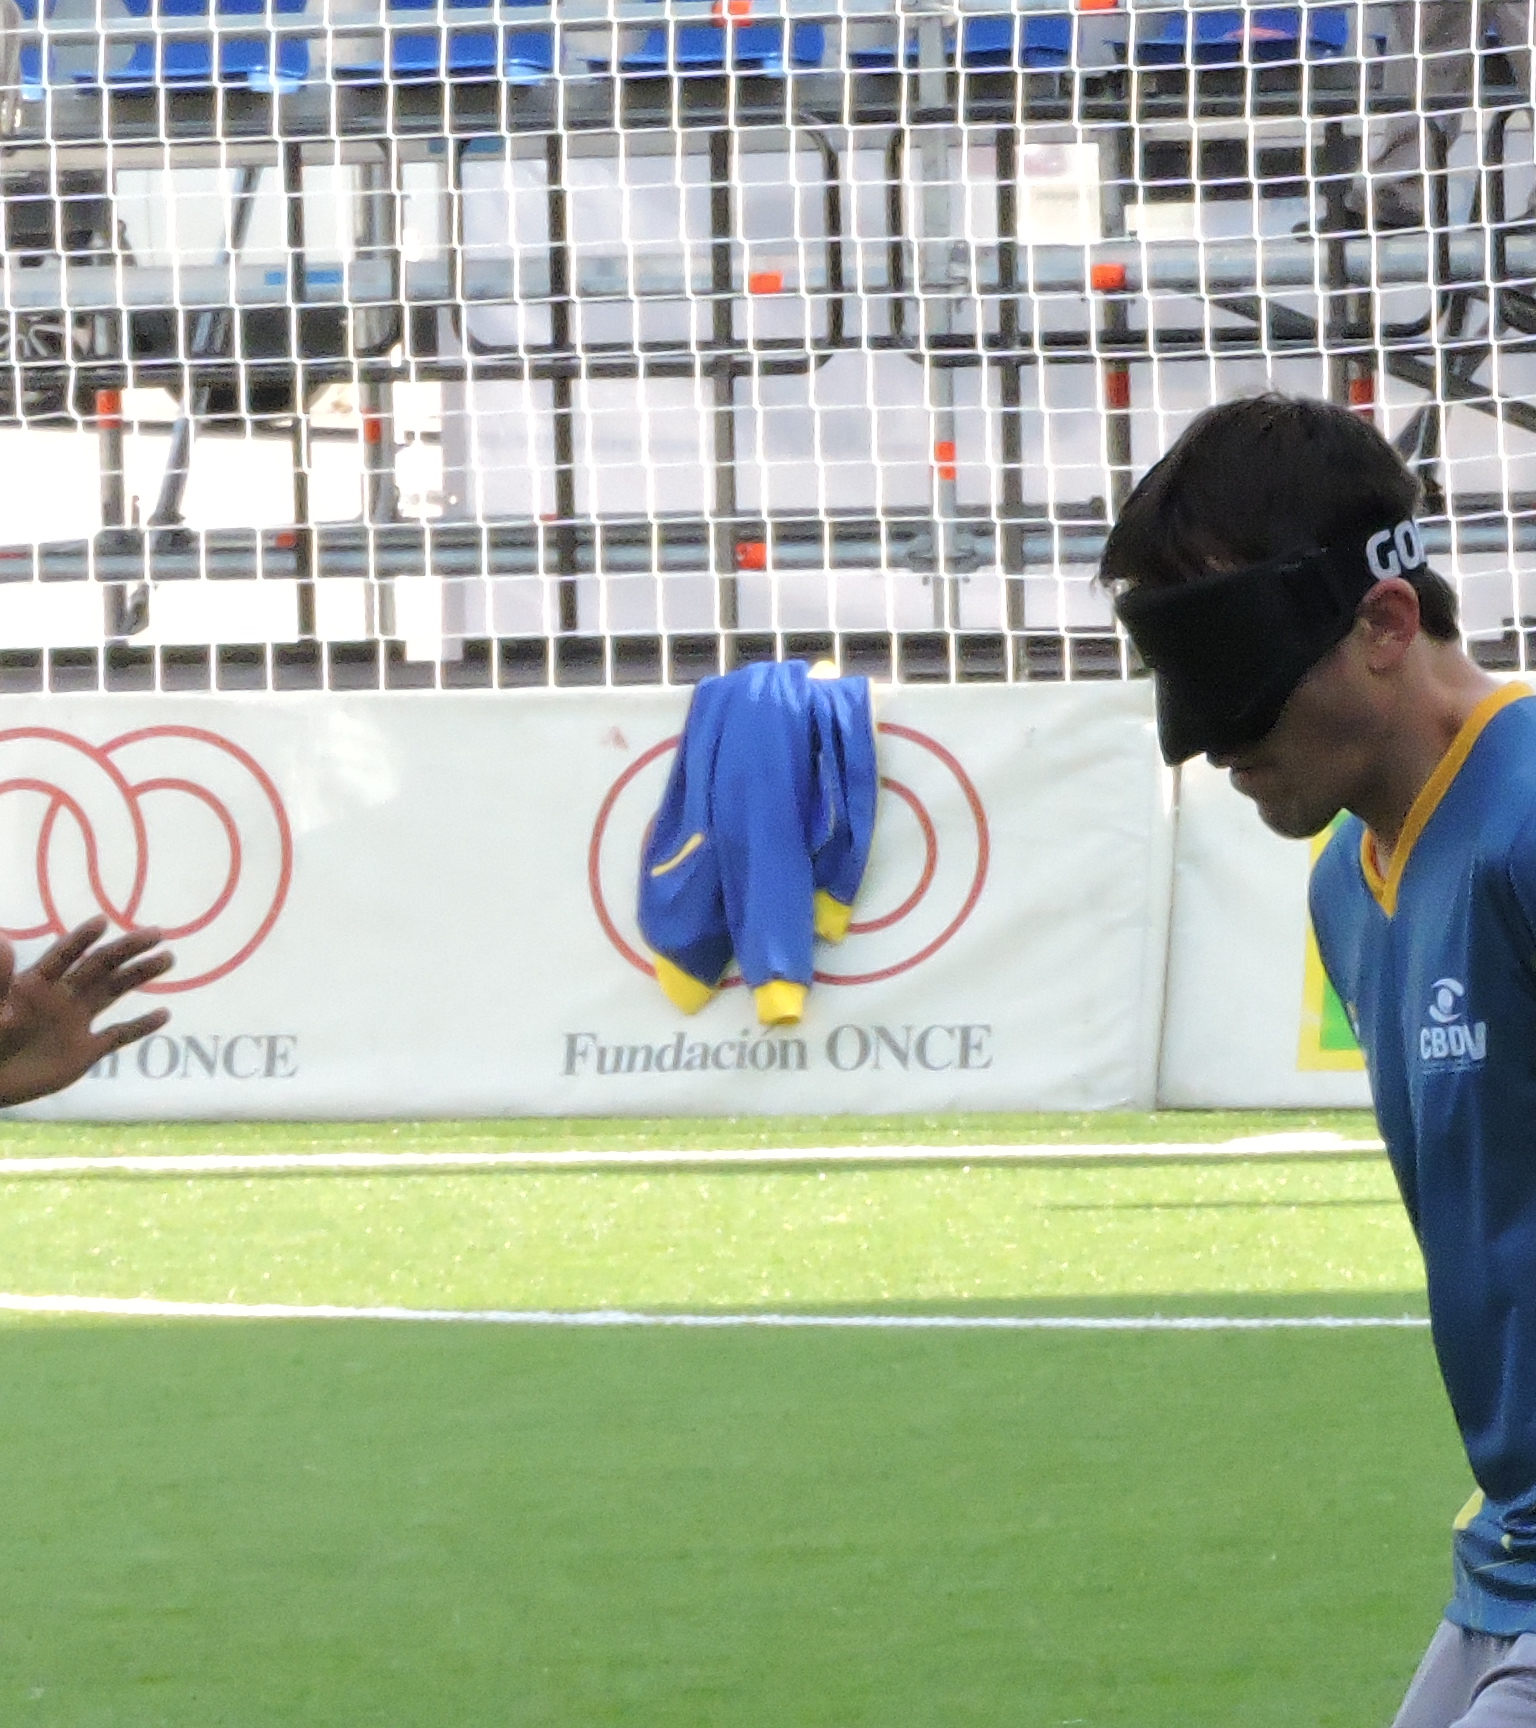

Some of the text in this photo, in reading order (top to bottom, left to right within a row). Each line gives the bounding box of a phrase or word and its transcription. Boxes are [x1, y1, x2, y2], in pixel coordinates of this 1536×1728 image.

[1365, 520, 1427, 580] GO
[136, 1034, 299, 1080] ONCE
[561, 1023, 994, 1077] Fundación ONCE
